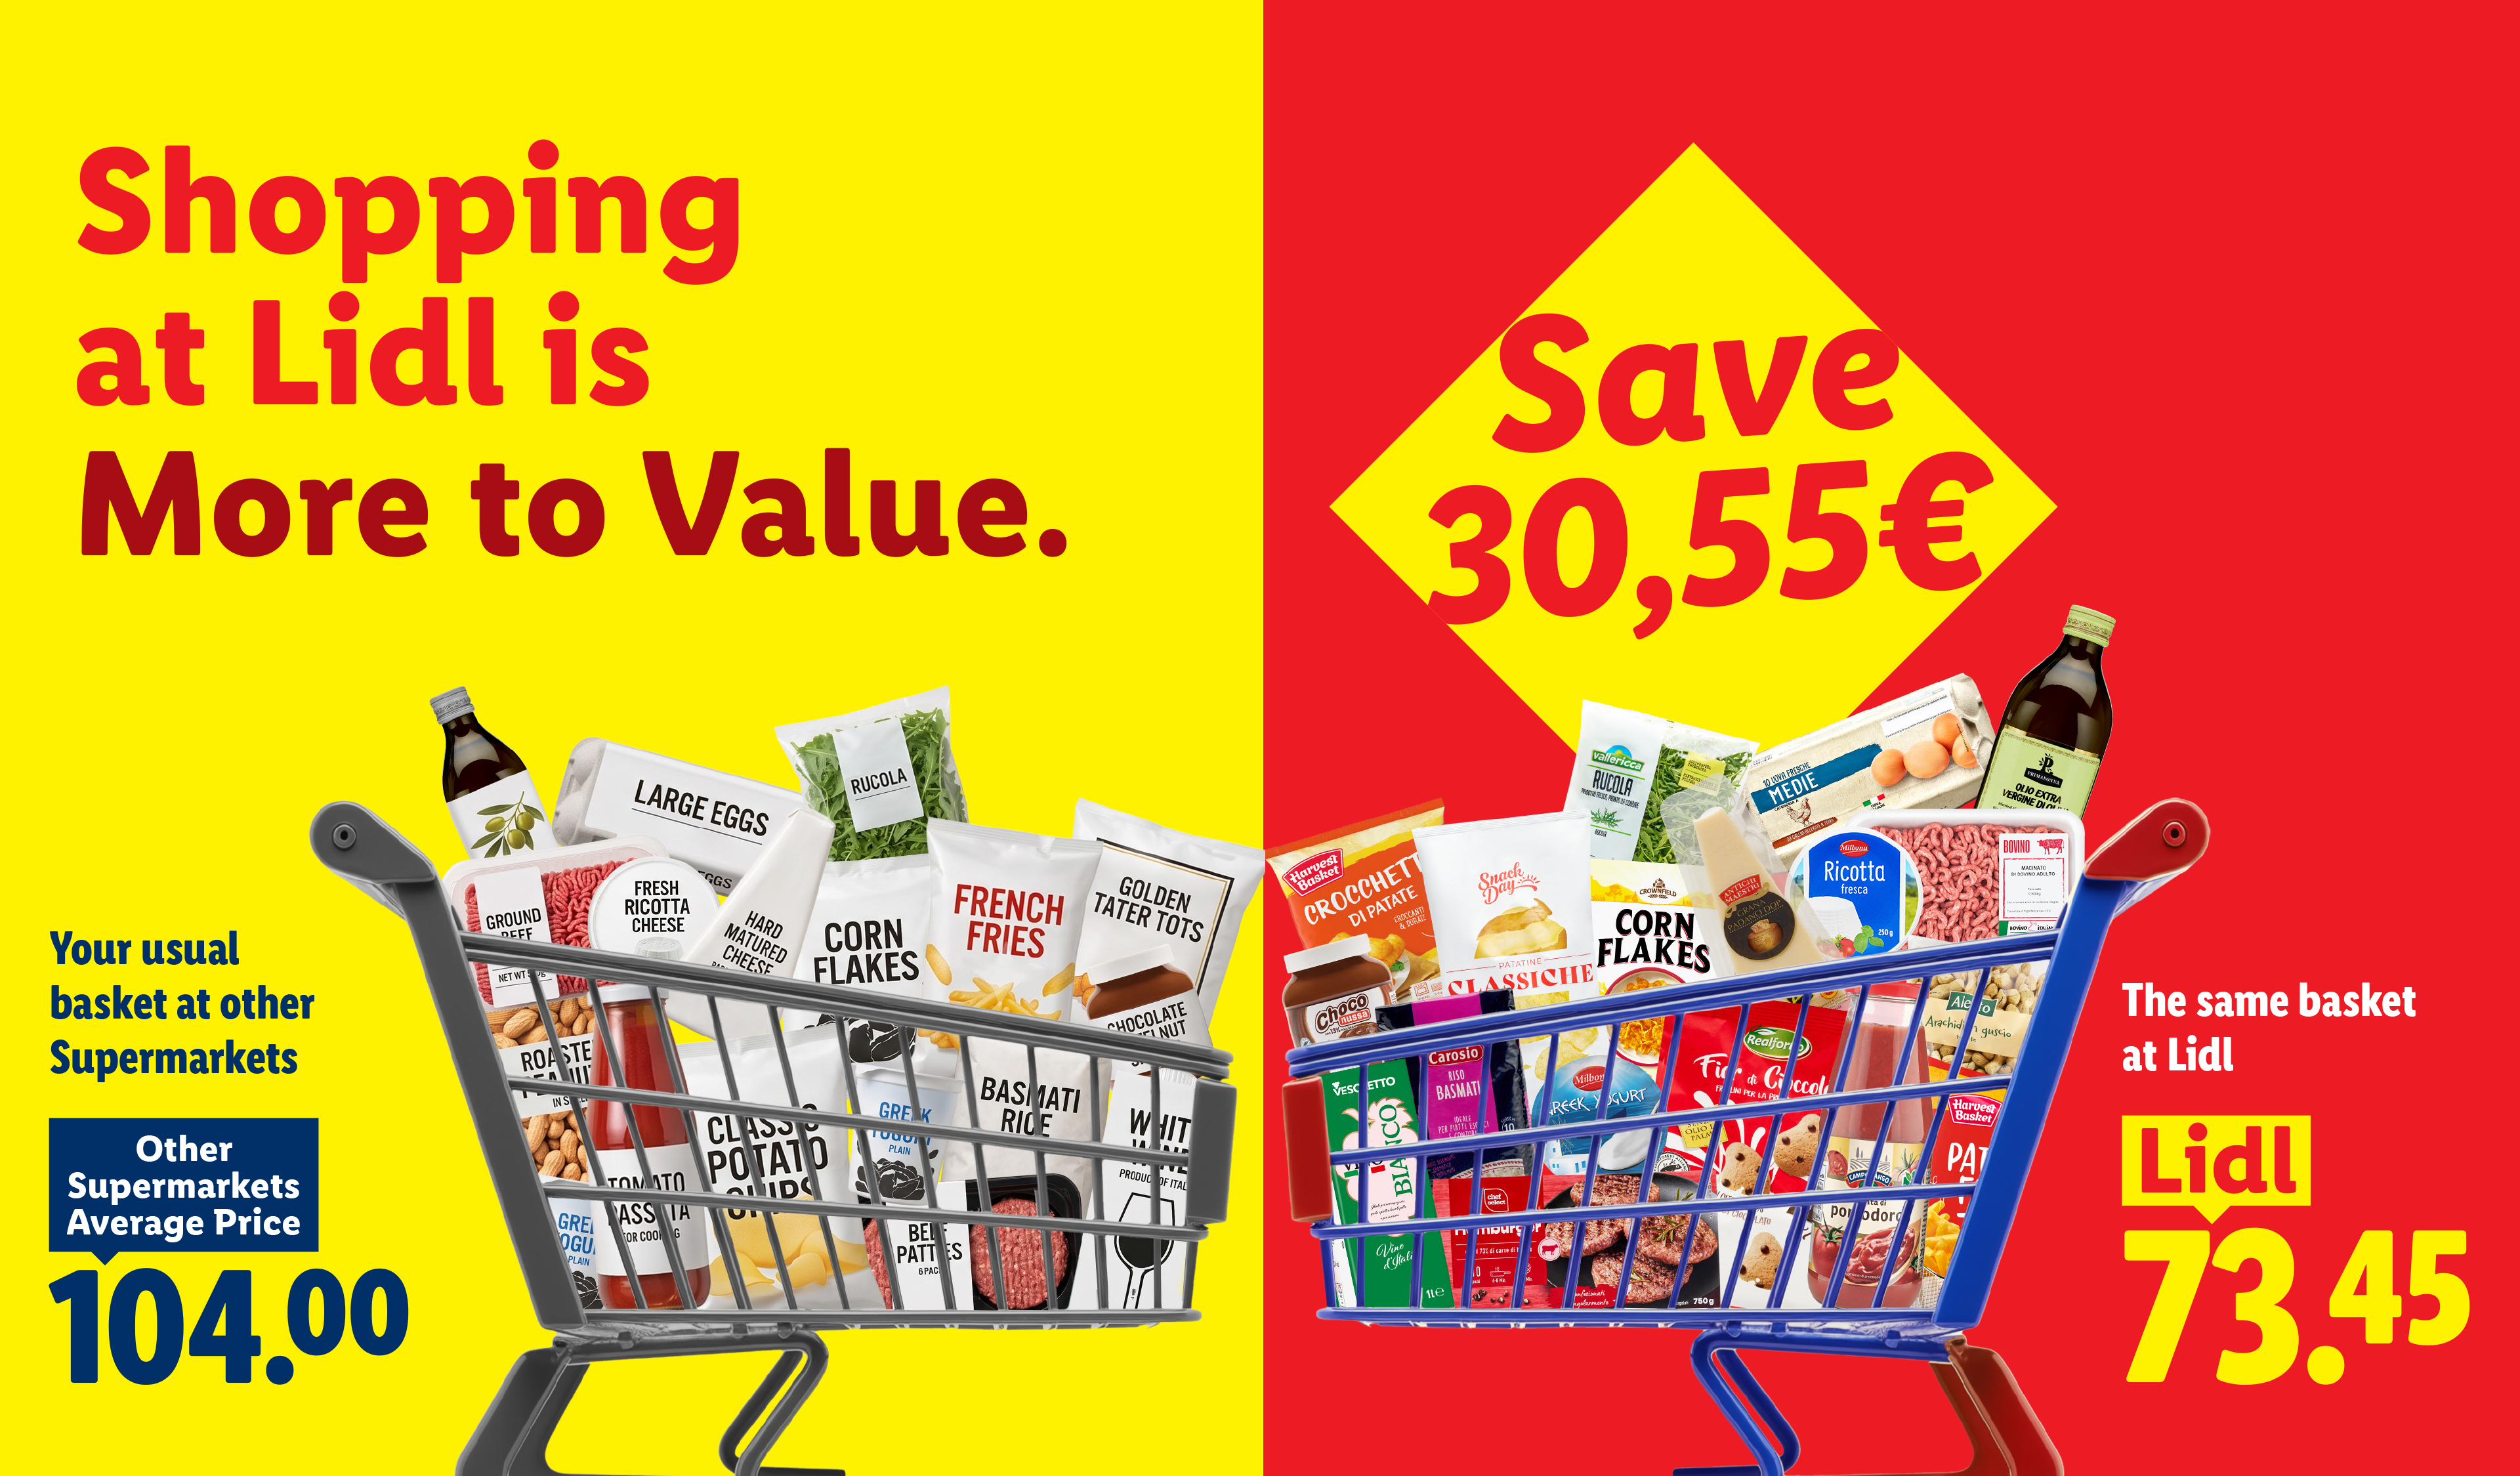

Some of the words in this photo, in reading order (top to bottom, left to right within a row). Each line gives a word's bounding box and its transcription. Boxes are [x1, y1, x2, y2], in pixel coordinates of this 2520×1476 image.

[78, 139, 738, 285] Shopping
[77, 312, 204, 406] at
[253, 291, 503, 406] Lidl
[543, 291, 649, 406] is
[1492, 313, 1899, 453] Save
[81, 451, 428, 557] More
[471, 463, 604, 557] to
[642, 448, 1066, 557] Value.
[1428, 451, 1994, 640] 30,55€
[1593, 751, 1642, 771] vallericca
[850, 768, 908, 795] RUCOLA
[1593, 770, 1633, 797] RUCOLA
[1763, 778, 1771, 788] 10
[1772, 771, 1786, 784] UOVA
[1786, 762, 1811, 778] FRESCHE
[2028, 770, 2060, 786] PRIMADONNA
[1768, 772, 1818, 805] MEDIE
[2003, 789, 2036, 807] VERGINE
[2016, 783, 2034, 795] OLIO
[2035, 790, 2061, 804] EXTRA
[634, 779, 713, 821] LARGE
[711, 799, 770, 837] EGGS
[1774, 801, 1795, 811] CATEGORIA
[2004, 839, 2030, 853] BOVINO
[1290, 854, 1339, 883] Harvest
[1297, 865, 1340, 891] Basket
[1479, 862, 1524, 891] Snack
[1824, 860, 1885, 882] Ricotta
[635, 880, 679, 896] FRESH
[1119, 876, 1191, 914] GOLDEN
[1304, 852, 1423, 925] CROCCHETT
[1482, 878, 1526, 904] Day
[1639, 887, 1677, 897] CROWNFIELD
[1724, 877, 1757, 899] ANTICHI
[1725, 883, 1761, 904] MAESTRI
[1841, 883, 1868, 895] fresca
[625, 898, 690, 915] RICOTTA
[954, 883, 1065, 925] FRENCH
[1094, 891, 1151, 928] TATER
[1156, 910, 1204, 942] TOTS
[1348, 909, 1367, 927] DI
[1366, 885, 1418, 918] PATATE
[1727, 910, 1763, 931] PADANO
[1763, 900, 1780, 912] DOP
[1737, 900, 1767, 917] GRANA
[486, 908, 541, 930] GROUND
[632, 917, 685, 933] CHEESE
[745, 910, 784, 939] HARD
[1406, 914, 1427, 927] DORATE
[1616, 908, 1695, 940] CORN
[50, 931, 131, 965] Your
[142, 931, 239, 965] usual
[724, 923, 788, 963] MATURED
[825, 918, 903, 952] CORN
[967, 920, 1045, 958] FRIES
[723, 945, 774, 975] CHEESE
[814, 950, 919, 984] FLAKES
[1499, 958, 1542, 969] PATATINE
[1597, 937, 1712, 974] FLAKES
[498, 973, 513, 982] NET
[514, 971, 526, 980] WT
[1448, 963, 1593, 996] CLASSICHE
[49, 985, 167, 1019] basket
[177, 990, 210, 1019] at
[220, 985, 315, 1019] other
[1316, 994, 1368, 1031] Choco
[1951, 996, 1990, 1013] Aleto
[2122, 982, 2186, 1017] The
[2196, 992, 2288, 1017] same
[2300, 982, 2416, 1017] basket
[1341, 1011, 1368, 1024] nussa
[1747, 1034, 1804, 1052] Realforo
[1982, 1028, 2011, 1038] guscio
[51, 1040, 298, 1083] Supermarkets
[520, 1040, 594, 1072] ROASTE
[1429, 1047, 1479, 1065] Carosio
[2123, 1042, 2156, 1072] at
[2169, 1035, 2234, 1072] Lidl
[1448, 1070, 1465, 1081] RISO
[1574, 1072, 1605, 1084] Milbon
[1748, 1074, 1757, 1085] di
[1764, 1065, 1830, 1095] Ciccol
[553, 1097, 562, 1108] IN
[980, 1076, 1081, 1114] BASMATI
[1436, 1080, 1480, 1100] BASMATI
[879, 1102, 932, 1123] GREK
[1952, 1099, 1996, 1114] Harvest
[1955, 1110, 1992, 1123] Basket
[707, 1103, 819, 1145] CLASSC
[1001, 1108, 1053, 1137] RICE
[1130, 1108, 1192, 1143] WHIT
[1438, 1126, 1448, 1134] PER
[1450, 1123, 1467, 1132] PIATTI
[1685, 1126, 1707, 1135] OLIO
[136, 1135, 232, 1162] Other
[1690, 1131, 1712, 1141] PALM
[707, 1136, 828, 1184] POTATO
[889, 1145, 911, 1155] PLAIN
[1947, 1143, 1989, 1175] PAT
[2141, 1122, 2296, 1194] Lidl
[68, 1171, 300, 1205] Supermarkets
[1120, 1169, 1151, 1183] PRODUC
[1160, 1177, 1169, 1187] OF
[1170, 1179, 1186, 1191] ITAL
[66, 1208, 204, 1243] Average
[213, 1206, 301, 1236] Price
[558, 1213, 593, 1234] GRE
[608, 1202, 690, 1226] ASSTA
[1732, 1211, 1771, 1225] CIOCLATO
[640, 1228, 680, 1242] COOG
[1455, 1223, 1541, 1236] mburgr
[558, 1233, 596, 1255] OGU
[897, 1242, 963, 1264] PATTS
[1376, 1242, 1404, 1257] Vino
[568, 1255, 590, 1266] PLAIN
[924, 1267, 940, 1275] PAC
[1384, 1251, 1413, 1271] d'Itali
[1575, 1290, 1605, 1298] onfezionati
[2124, 1227, 2469, 1385] 73.45
[49, 1268, 408, 1385] 104.00
